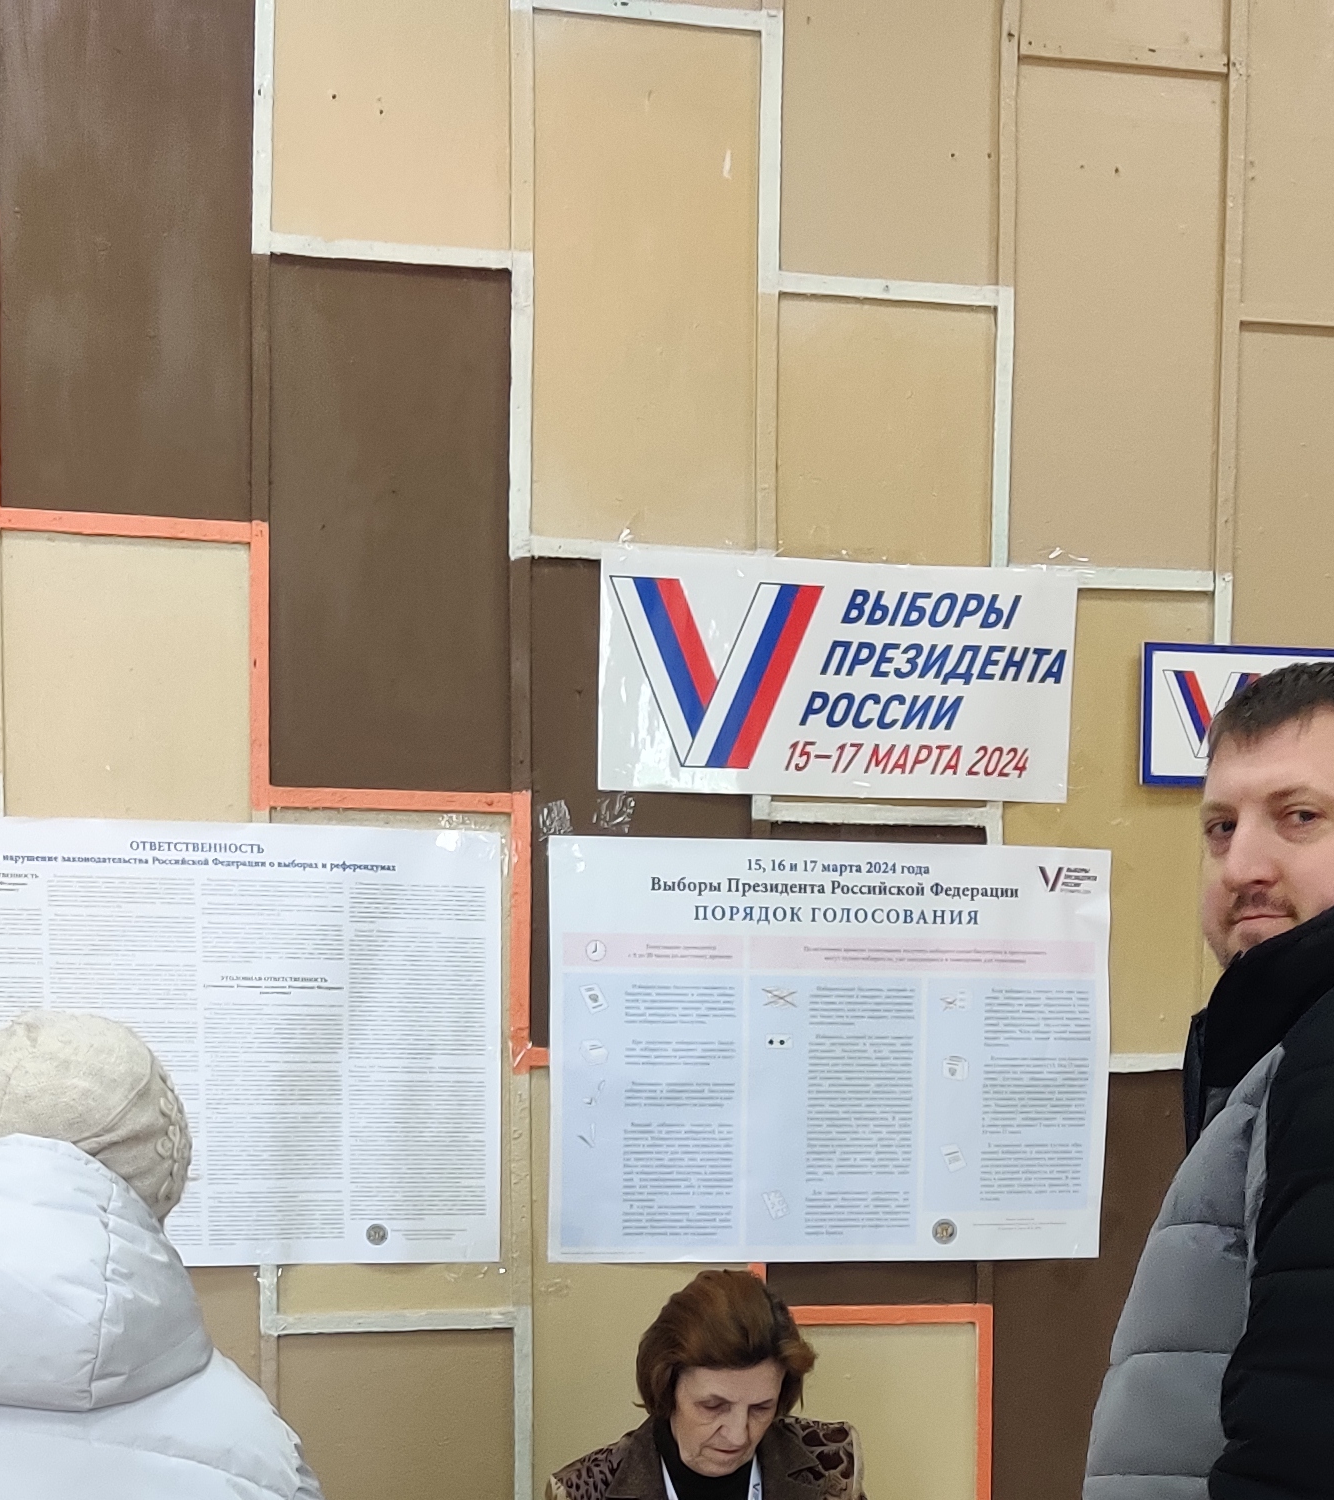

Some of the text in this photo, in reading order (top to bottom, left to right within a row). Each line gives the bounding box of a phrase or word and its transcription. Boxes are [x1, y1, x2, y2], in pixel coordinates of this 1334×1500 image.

[840, 588, 1023, 630] ВЫБОРЫ
[819, 639, 1068, 686] ПРЕЗИДЕНТА
[798, 691, 965, 731] РОССИИ
[864, 743, 964, 776] МАРТА
[965, 745, 1030, 779] 2024
[129, 840, 265, 854] ОТВЕТСТВЕННОСТЬ
[2, 854, 58, 864] нарушение
[61, 855, 149, 865] законодательства
[152, 856, 209, 866] Российской
[212, 858, 267, 869] Федерации
[277, 859, 318, 871] выборах
[329, 861, 397, 873] референдумах
[747, 858, 930, 876] 15, 16 и 17 марта 2024 года
[650, 876, 1019, 901] Выборы Президента Российской Федерации
[693, 905, 980, 926] ПОРЯДОК ГОЛОСОВАНИЯ
